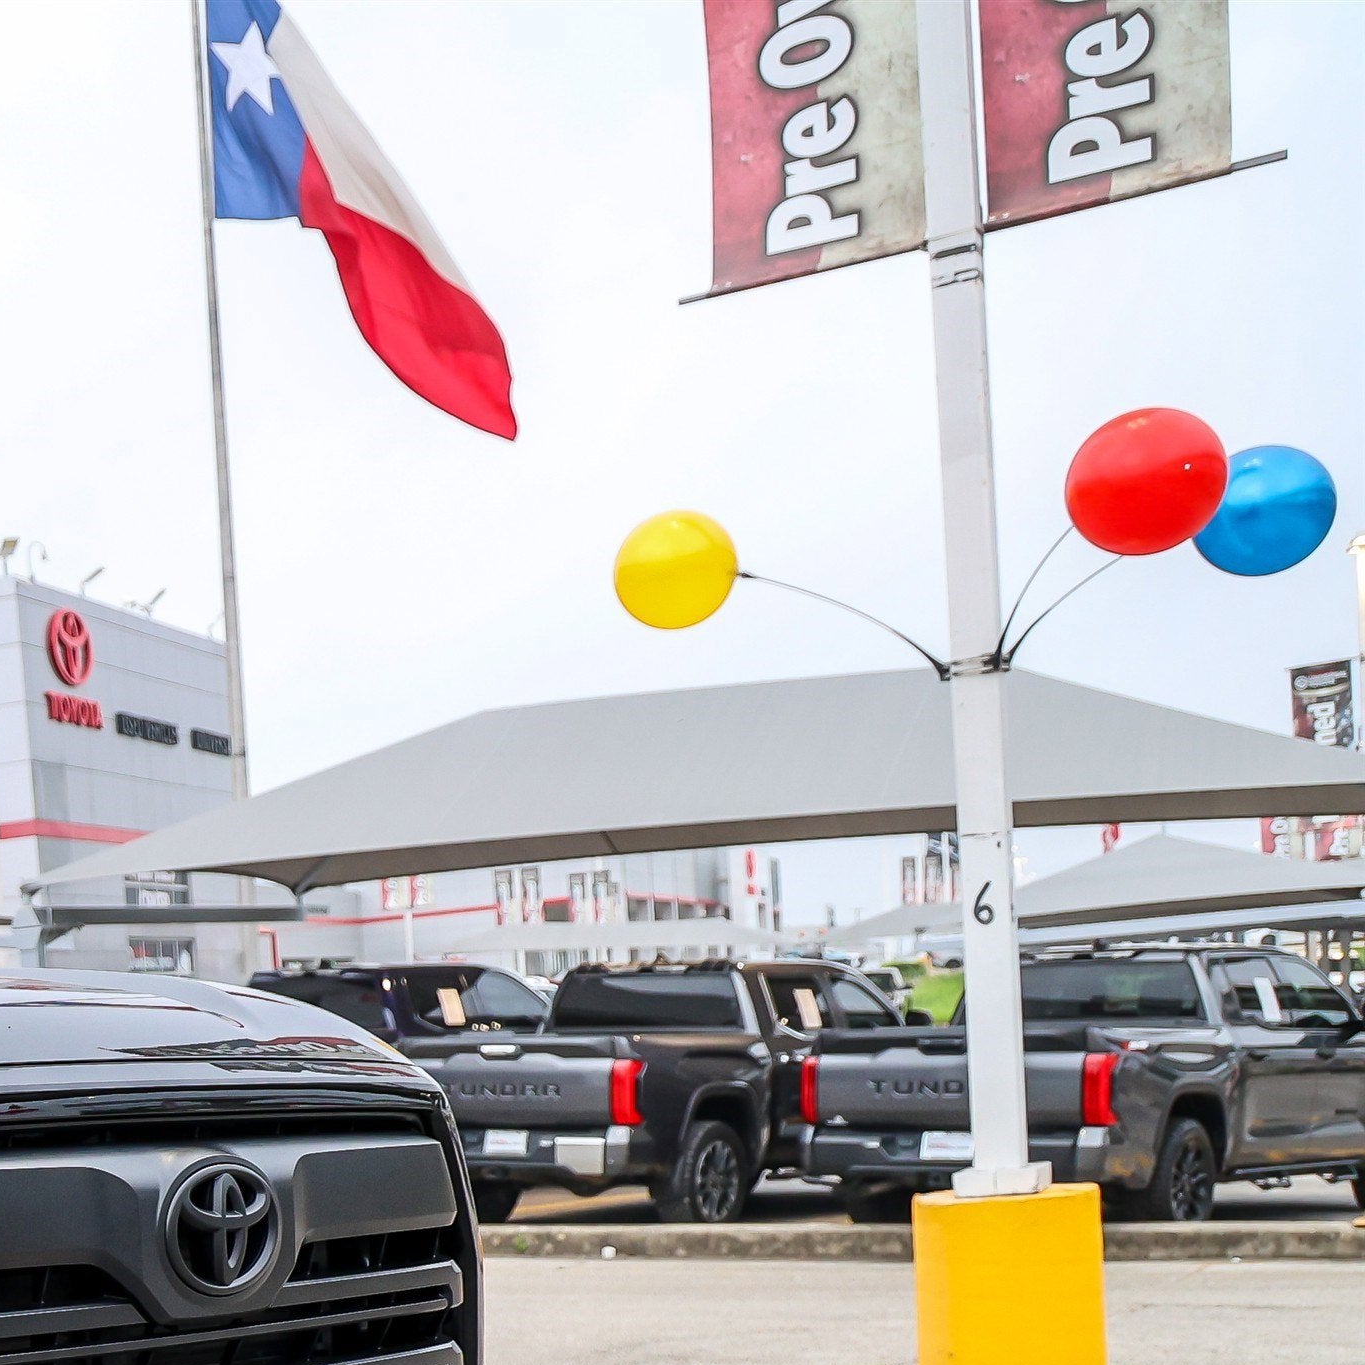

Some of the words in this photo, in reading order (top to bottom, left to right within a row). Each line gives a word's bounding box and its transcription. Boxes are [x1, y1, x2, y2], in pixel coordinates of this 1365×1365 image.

[758, 0, 856, 90] O
[1047, 9, 1158, 185] Pre
[764, 94, 862, 257] Pre
[1306, 700, 1337, 746] ned
[973, 880, 995, 926] 6
[867, 1079, 966, 1099] TUND
